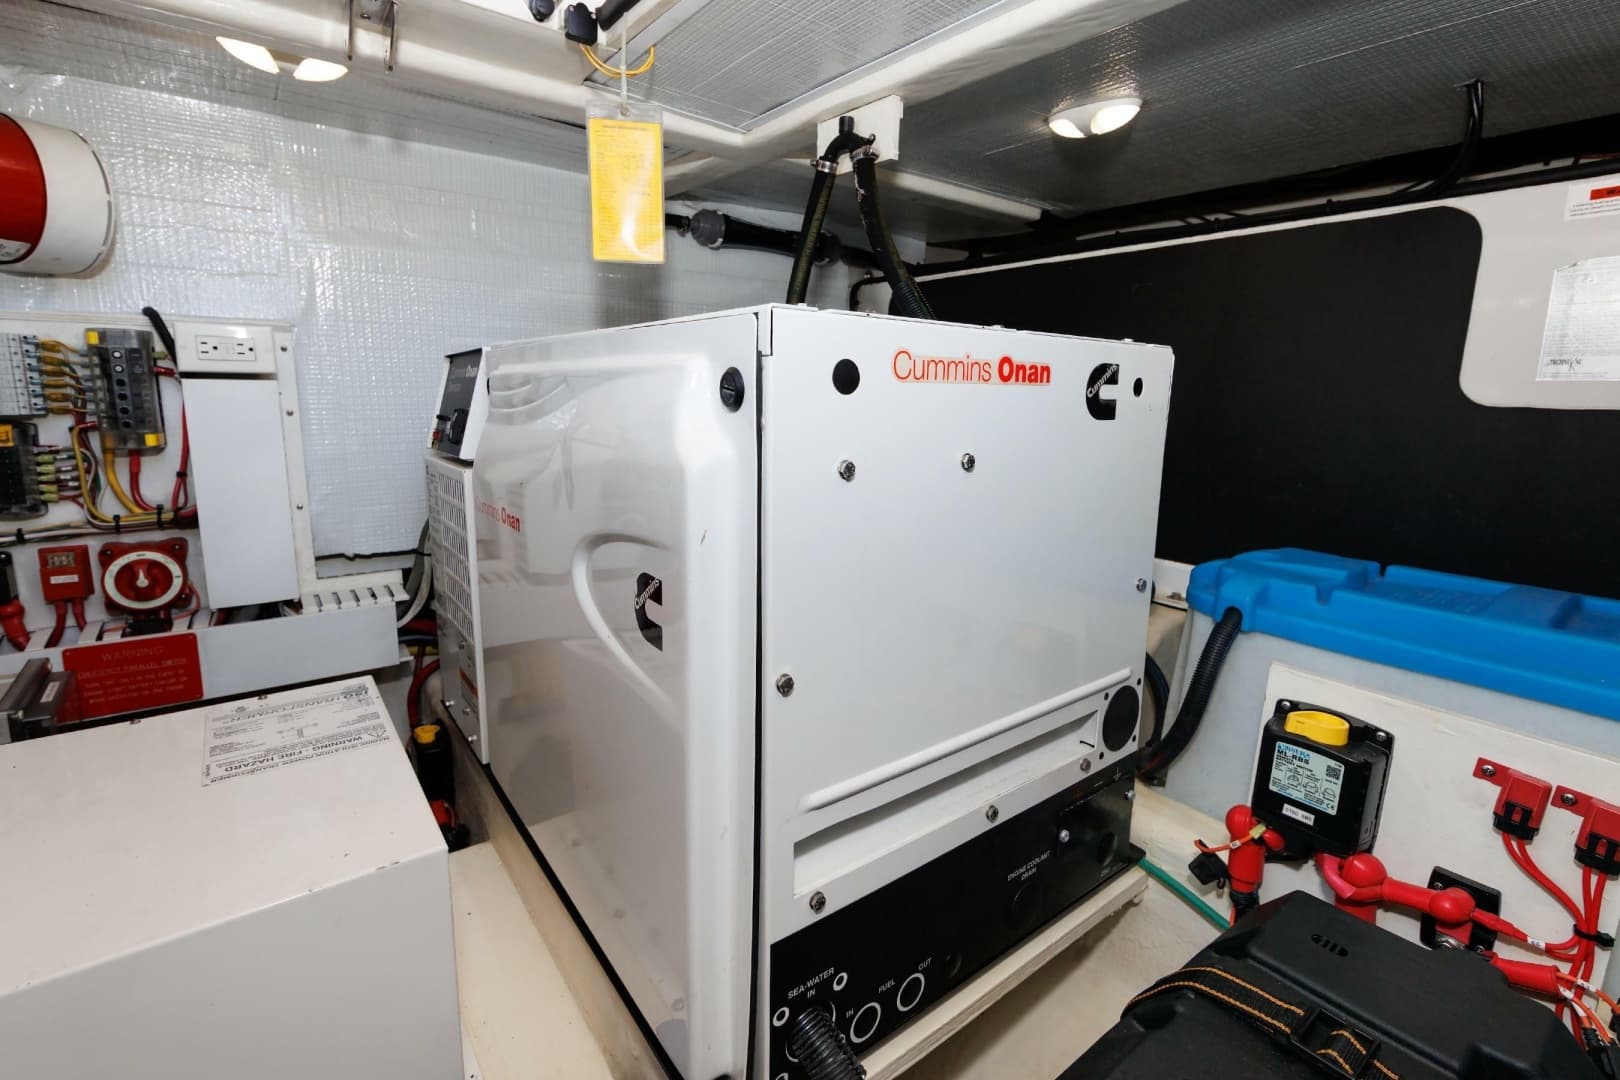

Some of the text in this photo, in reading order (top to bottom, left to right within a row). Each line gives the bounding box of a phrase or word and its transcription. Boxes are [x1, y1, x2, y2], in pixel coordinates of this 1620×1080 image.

[893, 350, 1051, 384] Cummins Onan
[1086, 364, 1118, 398] Cummins
[501, 506, 521, 533] Onan
[634, 578, 660, 610] Cummins
[311, 735, 363, 751] WARNING
[277, 749, 302, 761] FIRE
[1276, 749, 1310, 765] ML-RBS
[224, 757, 274, 773] HAZARD
[1007, 849, 1051, 882] ENGINE COOLANT
[1021, 866, 1037, 881] DRAIN
[918, 957, 933, 971] OUT
[787, 966, 835, 1000] SEA-WATER
[878, 978, 896, 995] FUEL
[807, 988, 817, 1000] IN
[846, 1007, 855, 1019] IN
